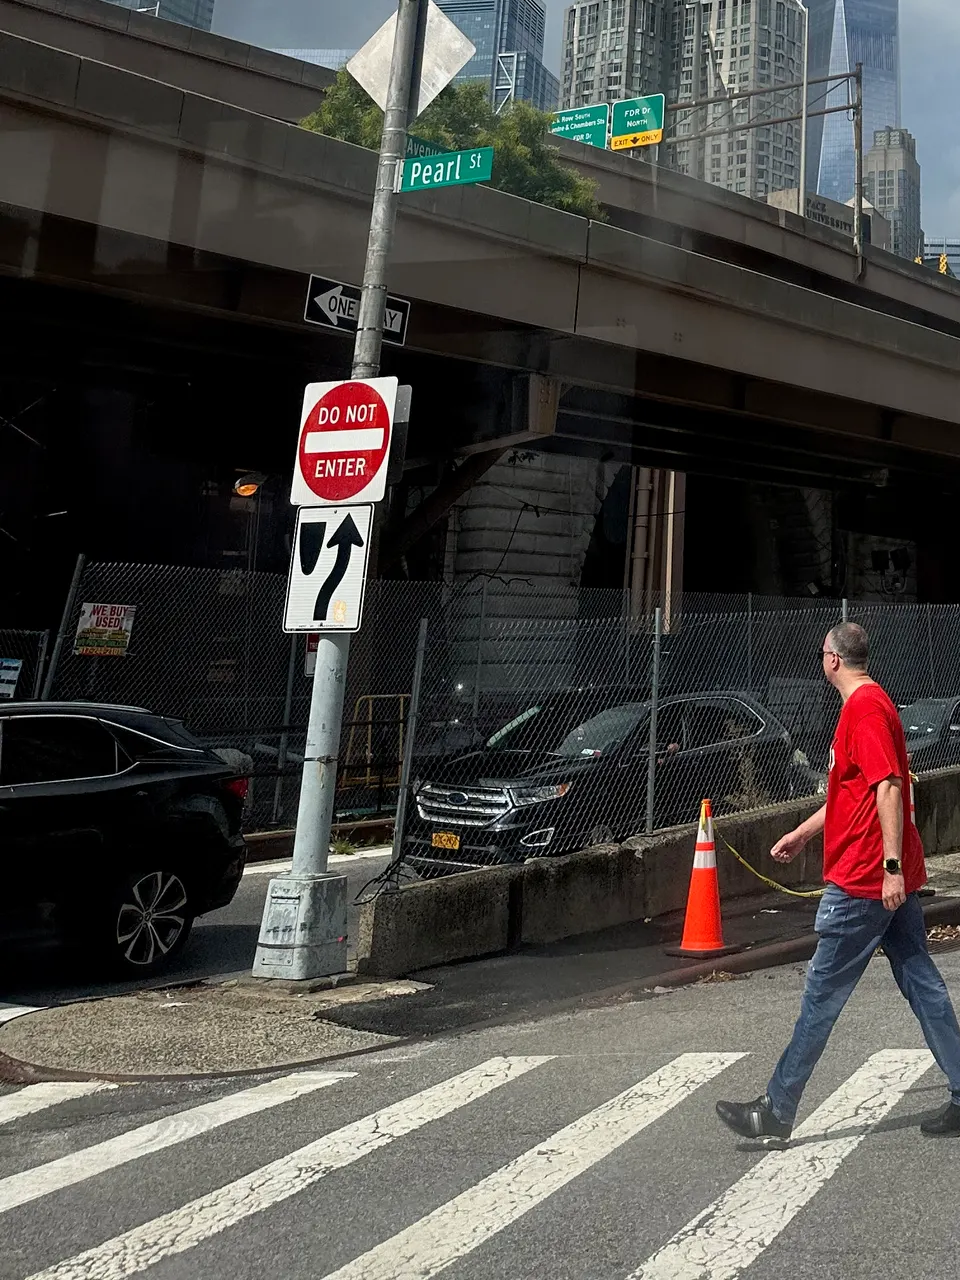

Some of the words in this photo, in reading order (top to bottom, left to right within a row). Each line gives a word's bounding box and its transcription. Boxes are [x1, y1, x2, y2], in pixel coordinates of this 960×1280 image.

[562, 115, 574, 123] Row
[624, 108, 640, 117] FDR
[570, 120, 596, 130] Chambers
[614, 138, 628, 147] EXIT
[641, 133, 659, 143] ONLY
[407, 138, 442, 158] Avenu
[410, 154, 461, 186] Pearl
[469, 152, 482, 169] St
[806, 197, 826, 212] PACE
[806, 208, 853, 232] UNIVERSITY
[328, 295, 356, 318] ONE
[318, 406, 340, 425] DO
[345, 403, 377, 423] NOT
[314, 457, 366, 478] ENTER
[91, 604, 108, 616] WE
[109, 605, 128, 617] BUY
[95, 617, 120, 628] USED
